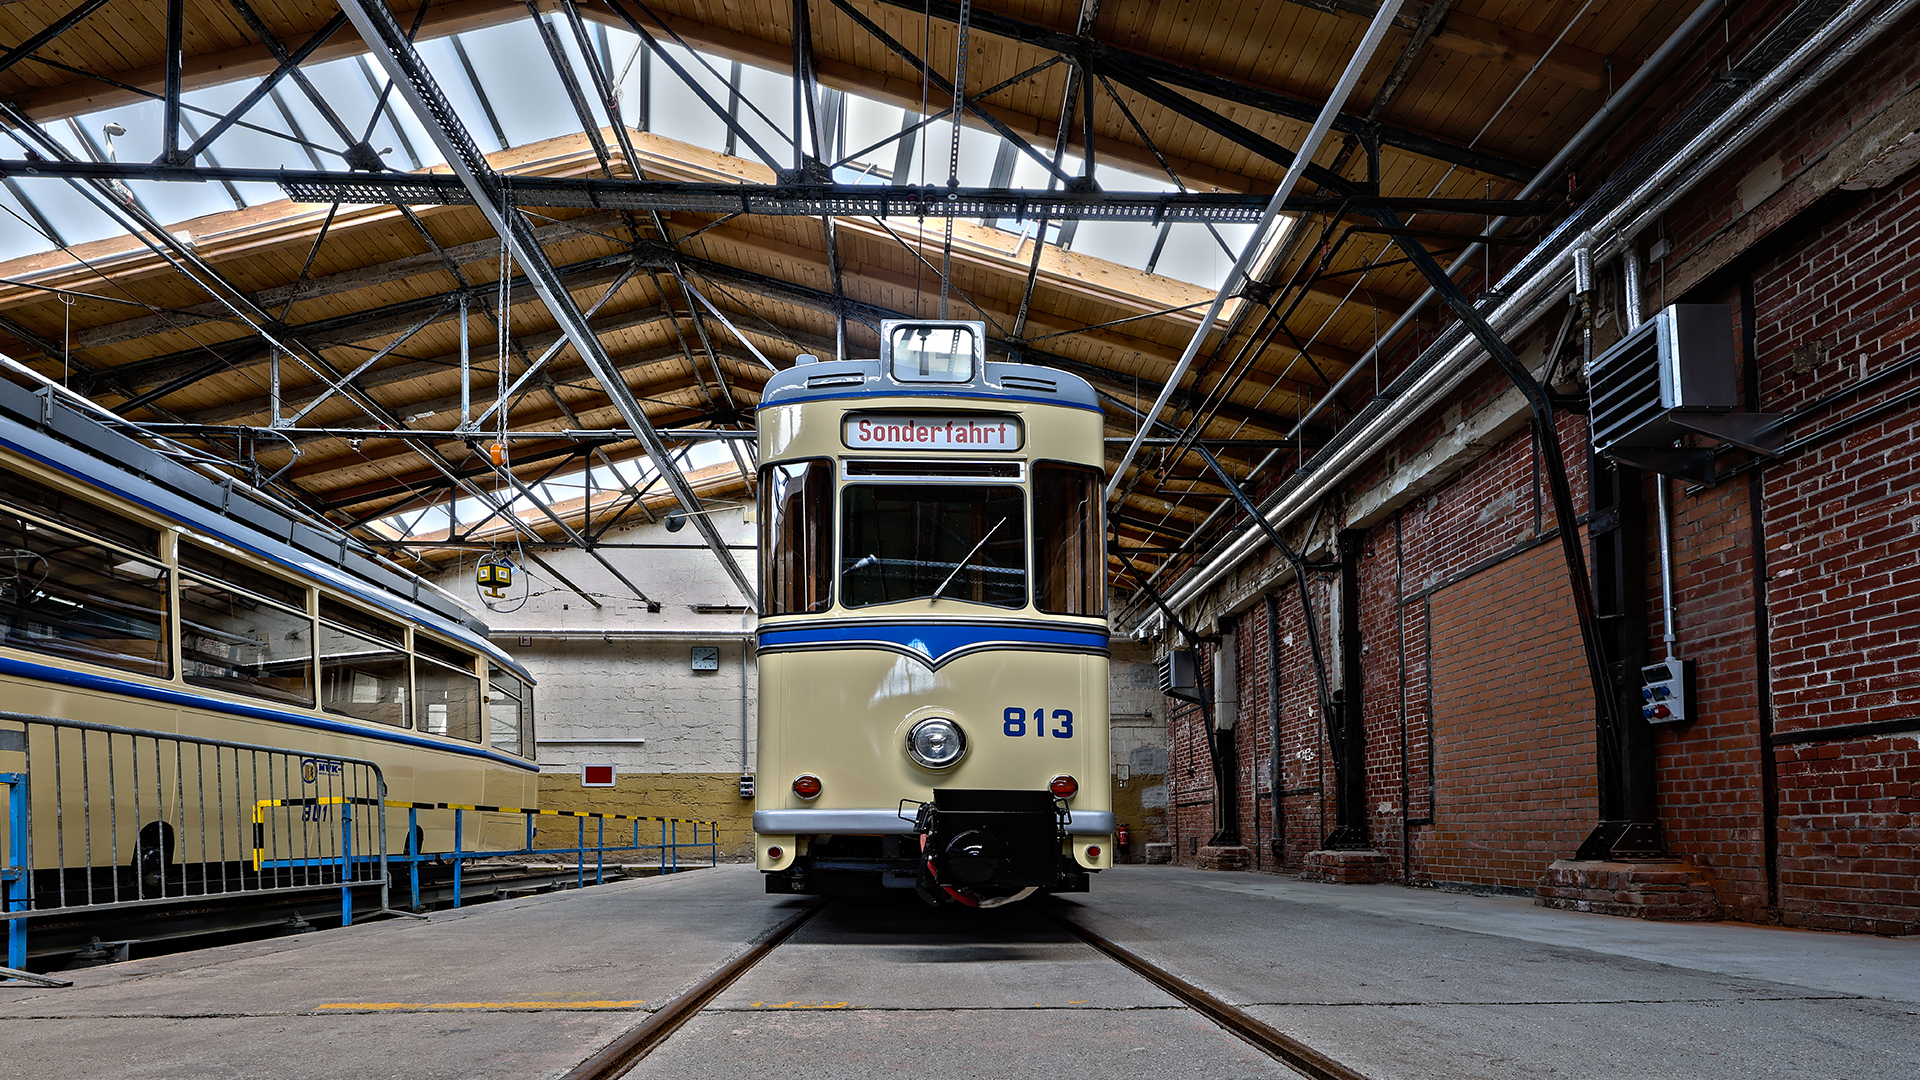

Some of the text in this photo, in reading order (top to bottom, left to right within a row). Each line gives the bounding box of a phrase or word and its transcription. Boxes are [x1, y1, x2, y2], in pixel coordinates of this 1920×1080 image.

[858, 419, 1006, 444] Sonderfahrt
[1003, 707, 1073, 738] 813
[301, 804, 328, 822] 801
